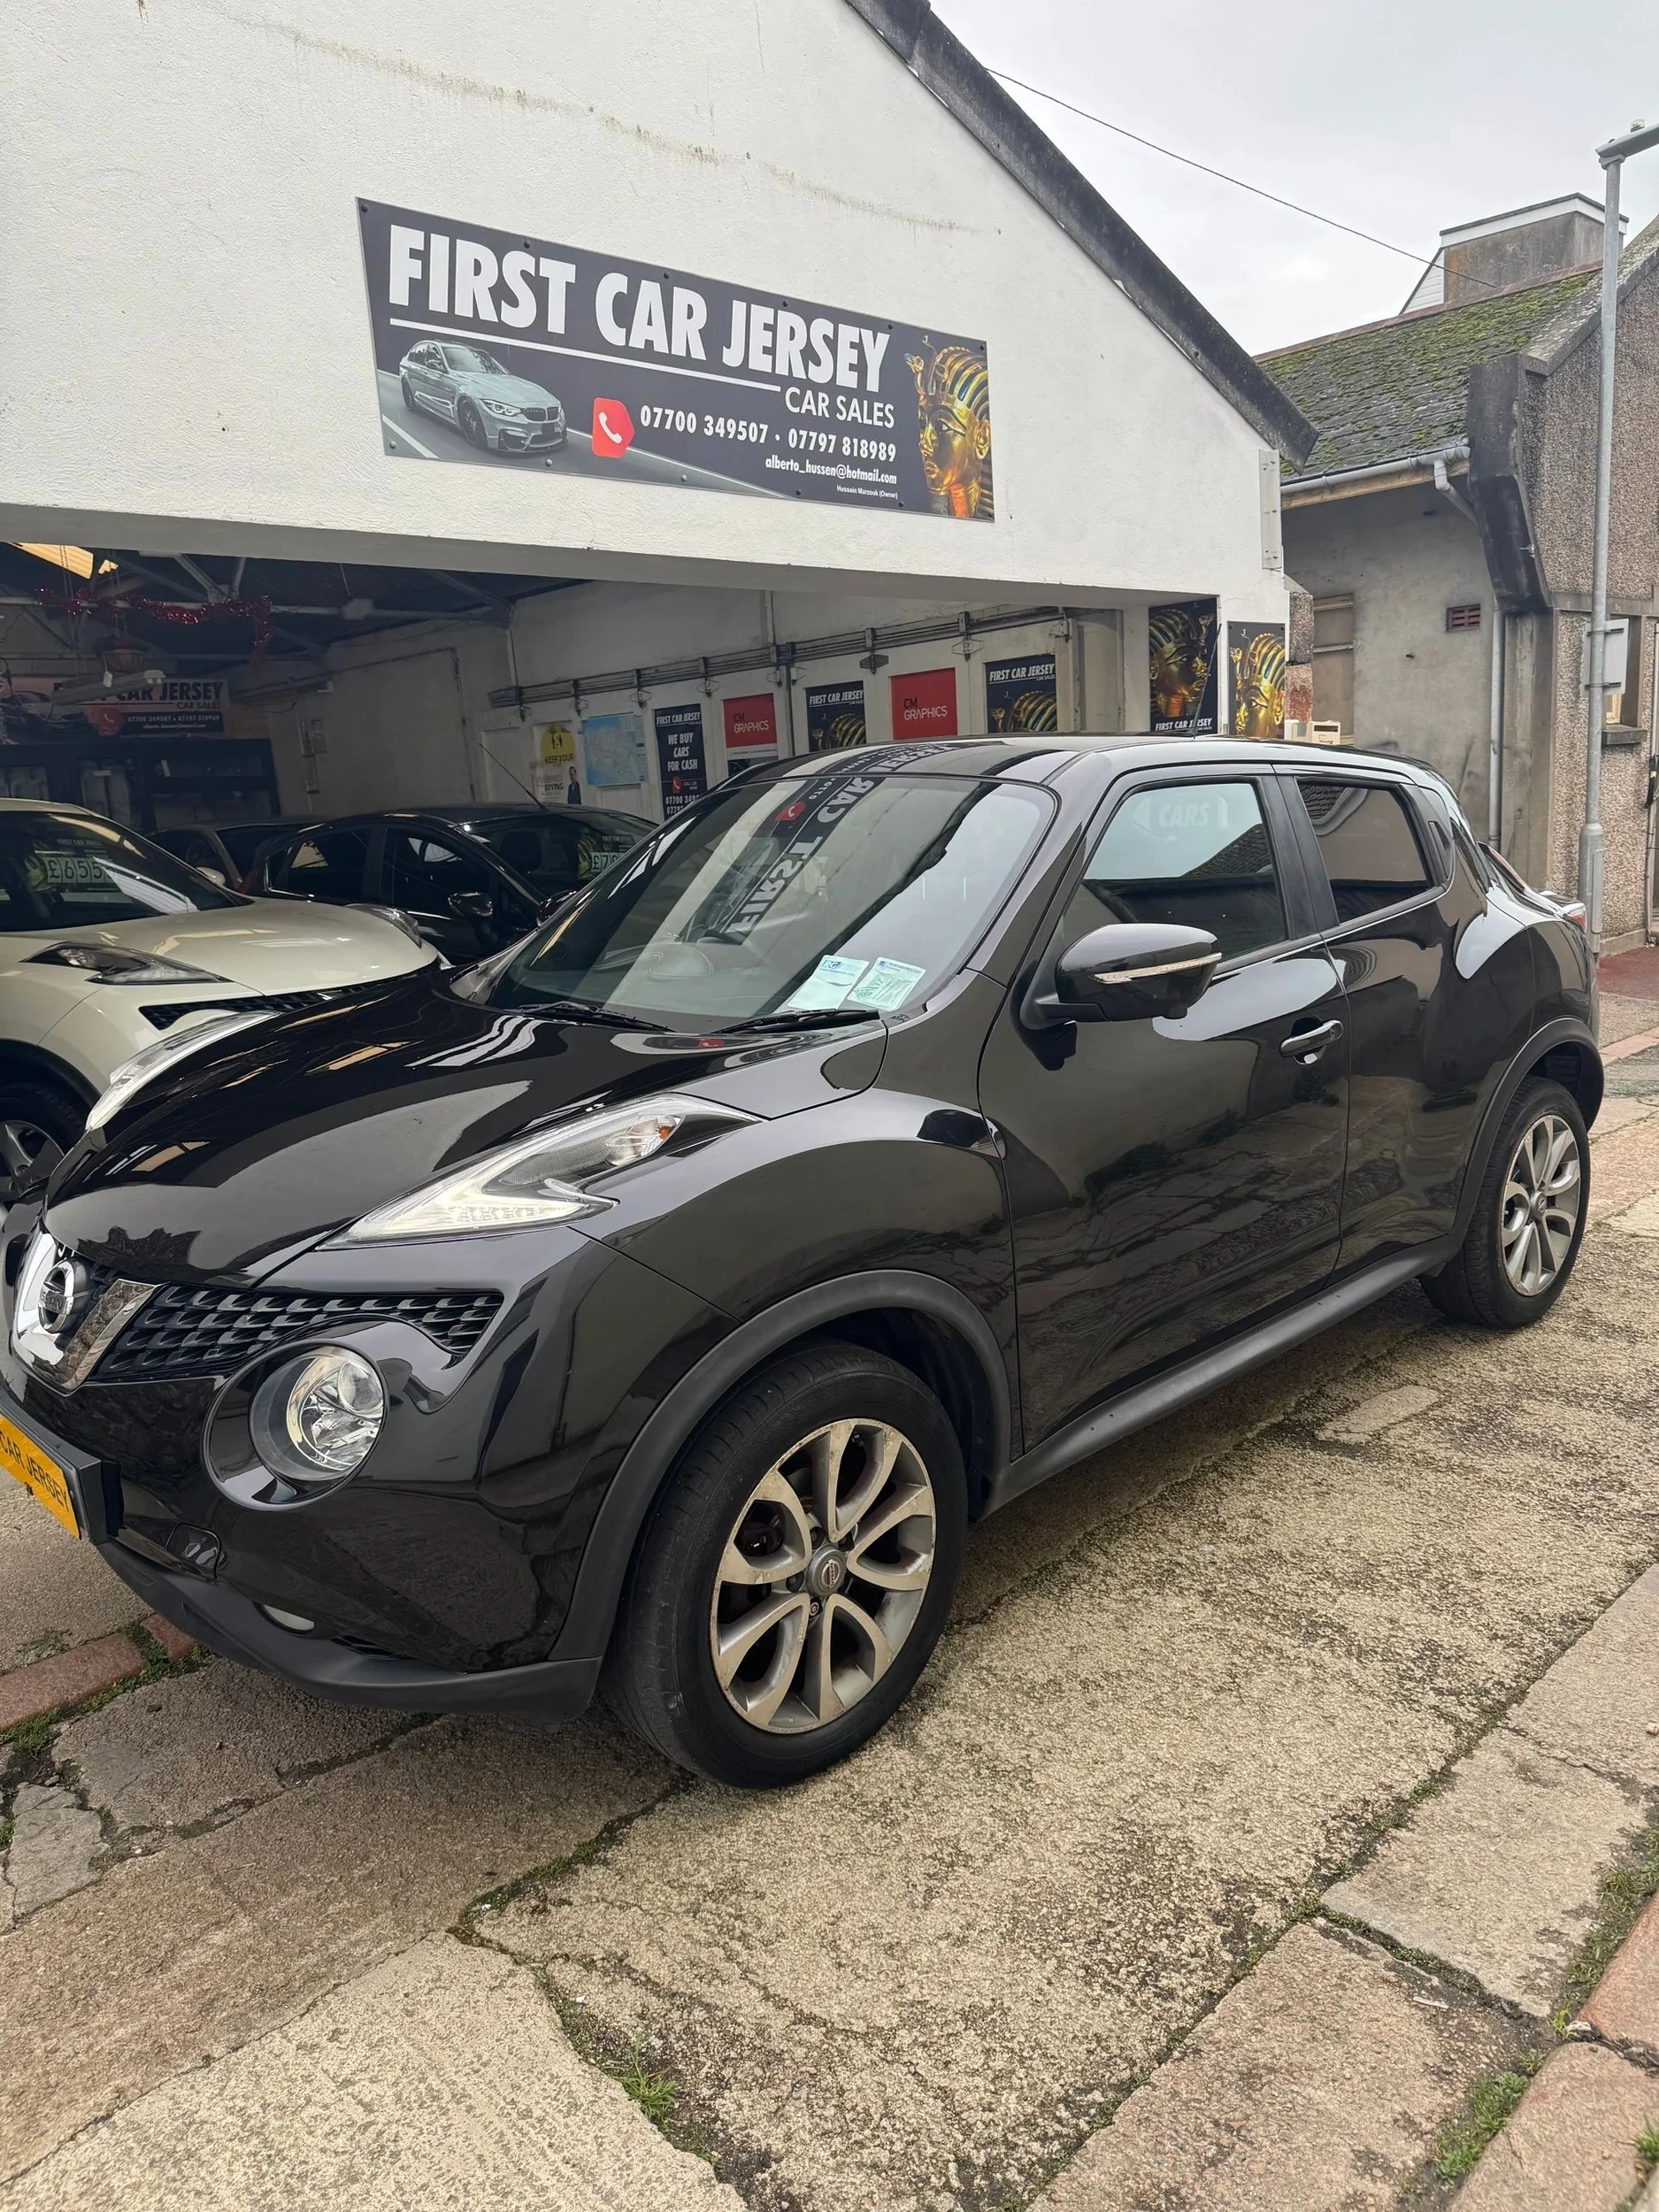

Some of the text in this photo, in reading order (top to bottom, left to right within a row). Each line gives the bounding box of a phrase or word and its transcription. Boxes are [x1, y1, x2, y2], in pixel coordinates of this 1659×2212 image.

[389, 224, 890, 393] FIRST CAR JERSEY
[785, 387, 895, 428] CAR SALES
[640, 405, 896, 463] 07700 349507 07797 818989
[765, 454, 897, 485] alberto_hussen@hotmail.com
[879, 490, 898, 500] (Owner)
[989, 664, 1055, 682] FIRST CAR JERSEY
[159, 682, 224, 701] JERSEY
[809, 690, 864, 705] FIRST CAR JERSEY
[657, 711, 701, 726] FIRST CAR JERSEY
[903, 705, 948, 721] GRAPHICS
[733, 720, 769, 733] GRAPHICS
[1155, 722, 1173, 732] FIRST
[1174, 720, 1188, 729] CAR
[667, 732, 694, 745] WE BUY
[544, 753, 574, 764] KEEP YOUR
[673, 746, 689, 758] CARS
[667, 758, 697, 772] FOR CASH
[0, 1430, 70, 1512] CAR JERSEY
